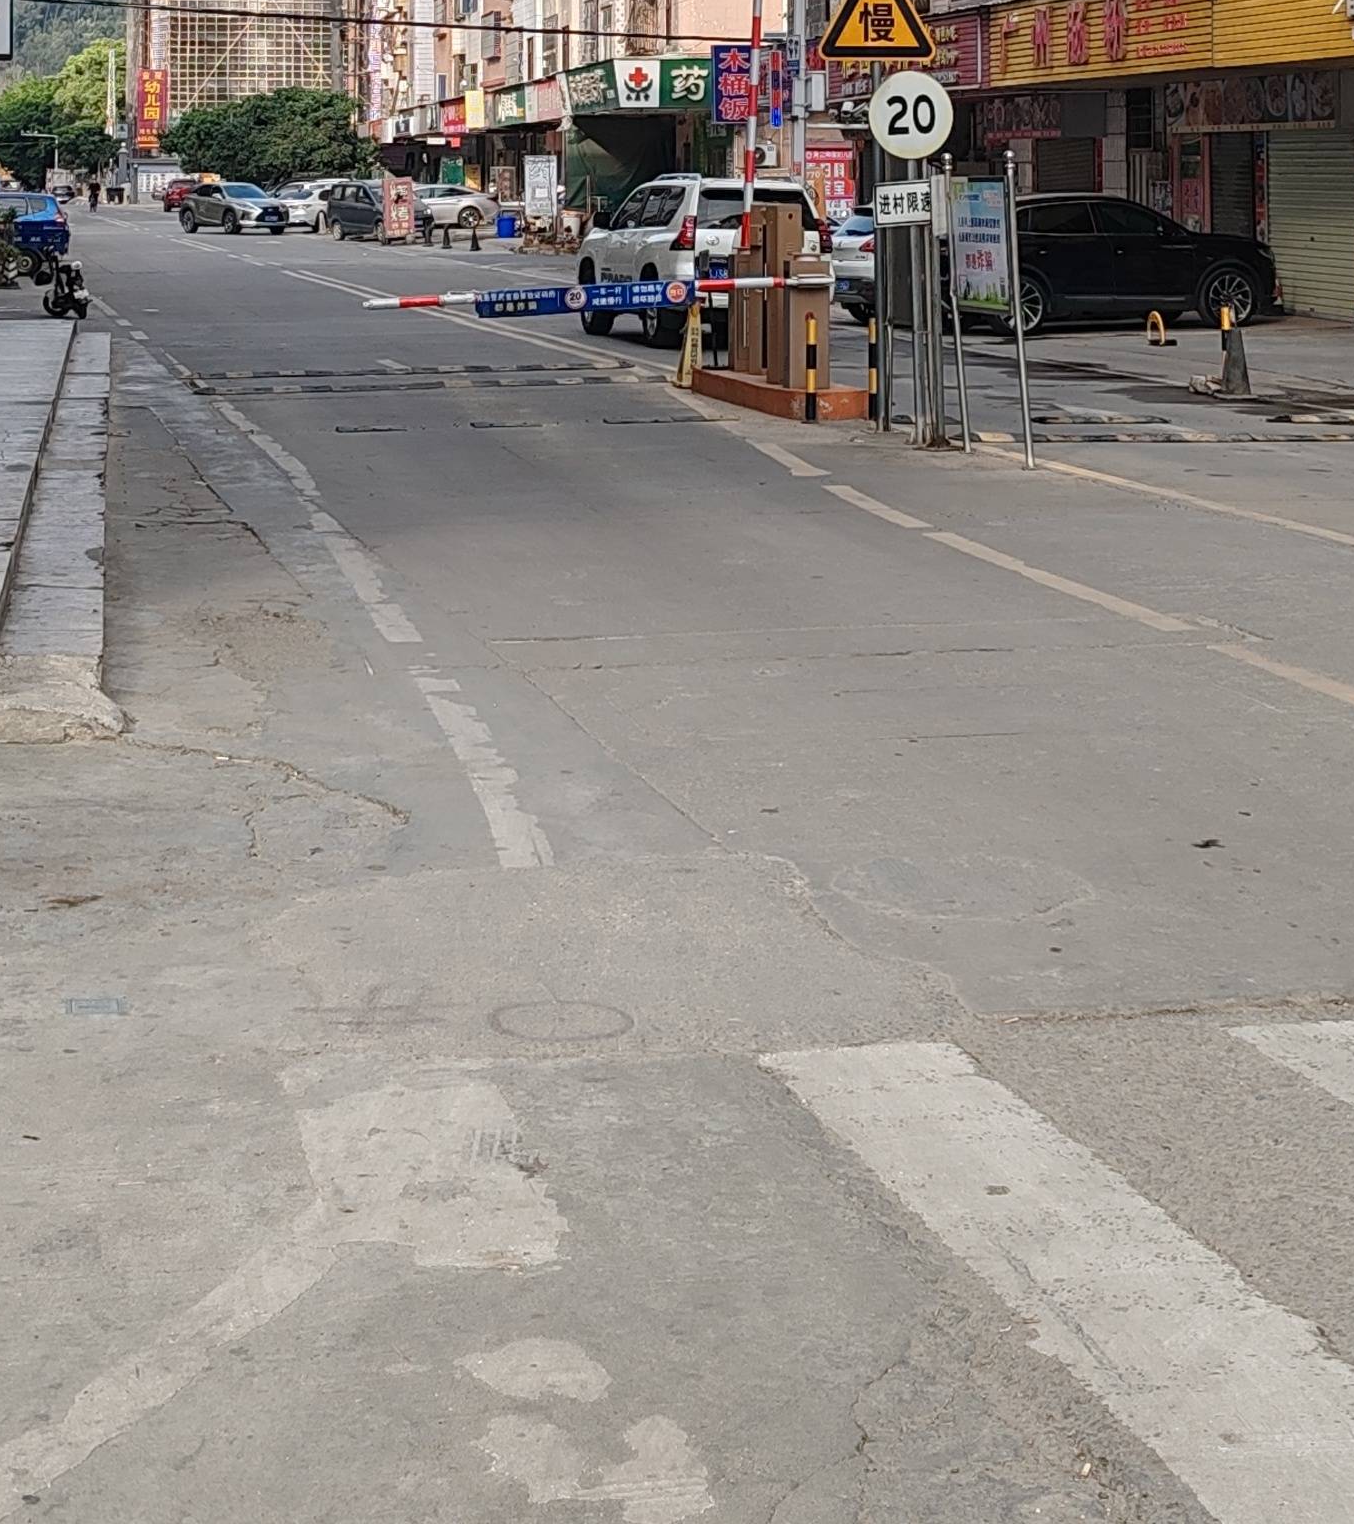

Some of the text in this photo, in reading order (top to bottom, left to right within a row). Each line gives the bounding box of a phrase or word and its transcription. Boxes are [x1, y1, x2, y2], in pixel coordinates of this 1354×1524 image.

[859, 2, 896, 43] 慢
[144, 80, 161, 121] 幼儿园
[669, 65, 709, 102] 药
[718, 48, 750, 121] 木桶饭
[886, 94, 936, 136] 20
[879, 191, 932, 215] 进村限速
[569, 291, 583, 302] 20
